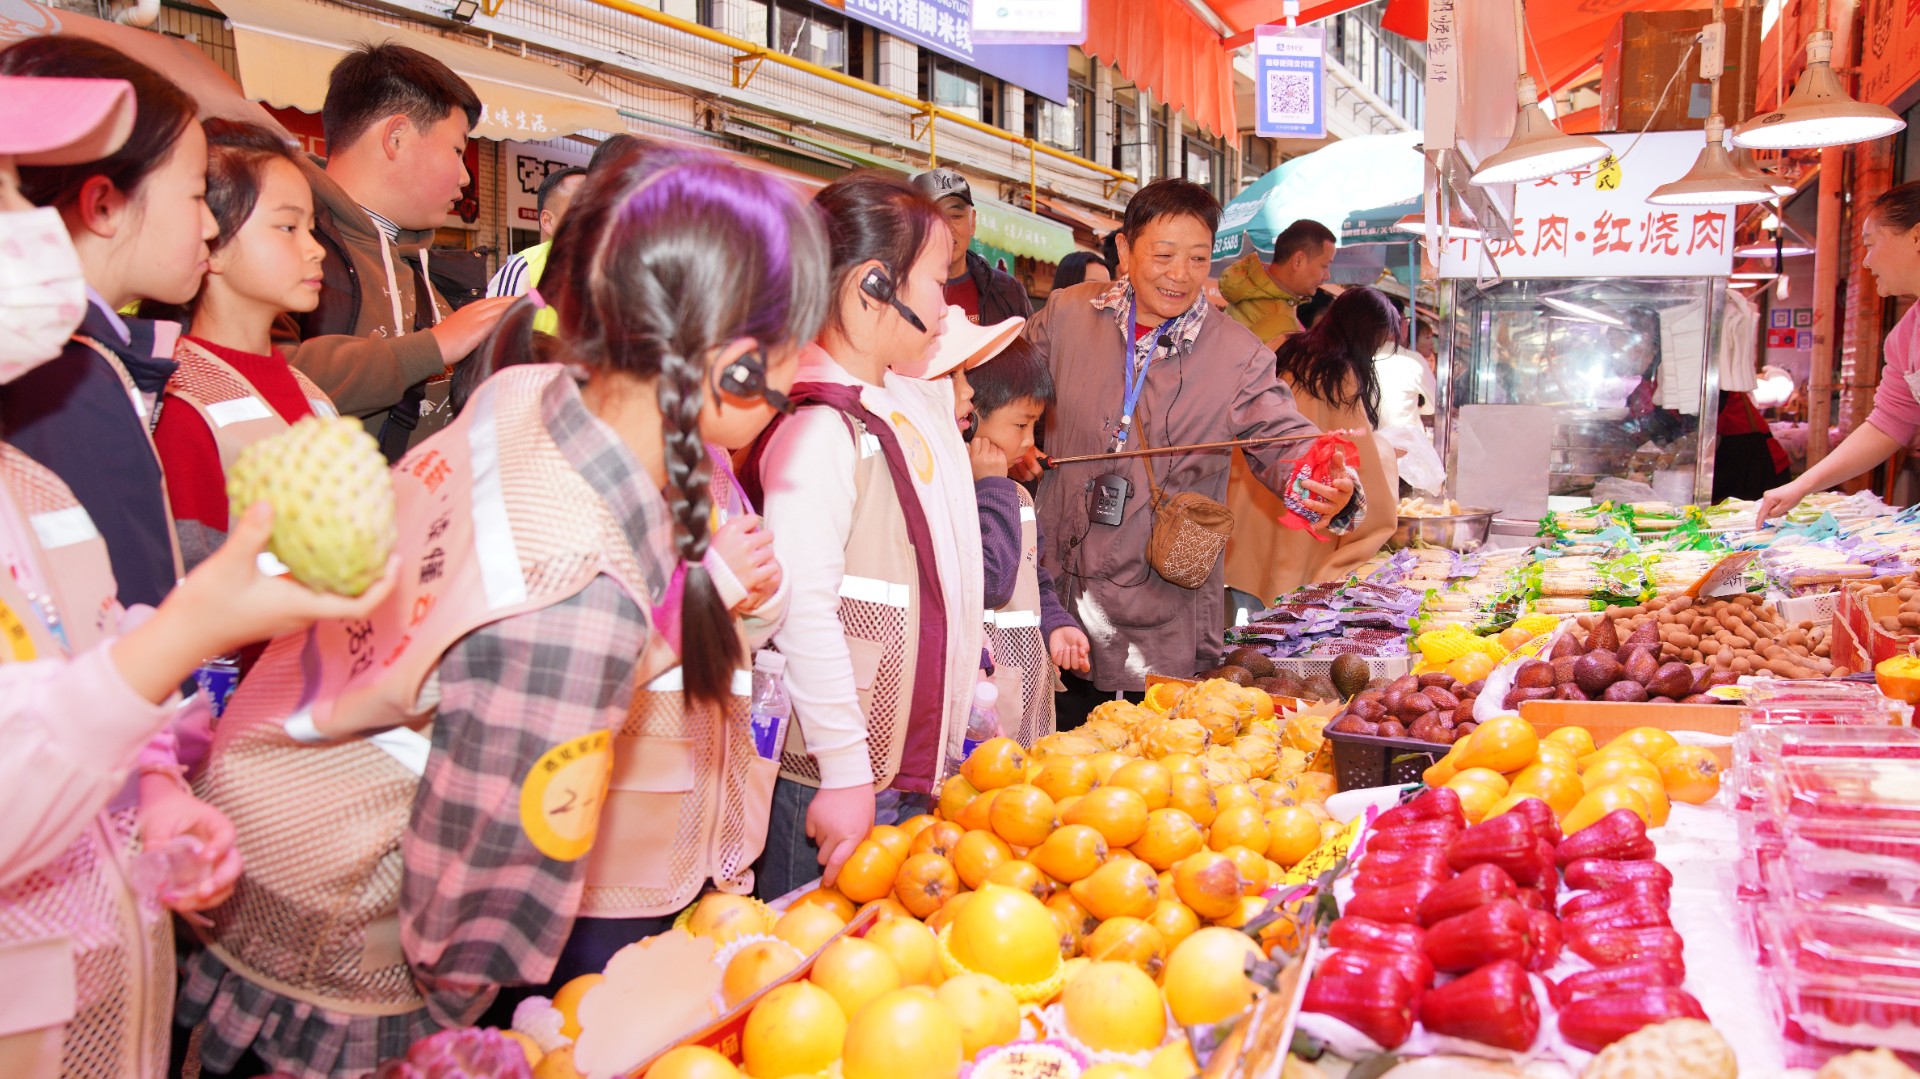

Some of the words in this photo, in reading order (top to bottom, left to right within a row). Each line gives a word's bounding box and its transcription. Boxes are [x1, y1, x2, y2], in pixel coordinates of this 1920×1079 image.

[846, 0, 974, 54] 肉猪脚米线
